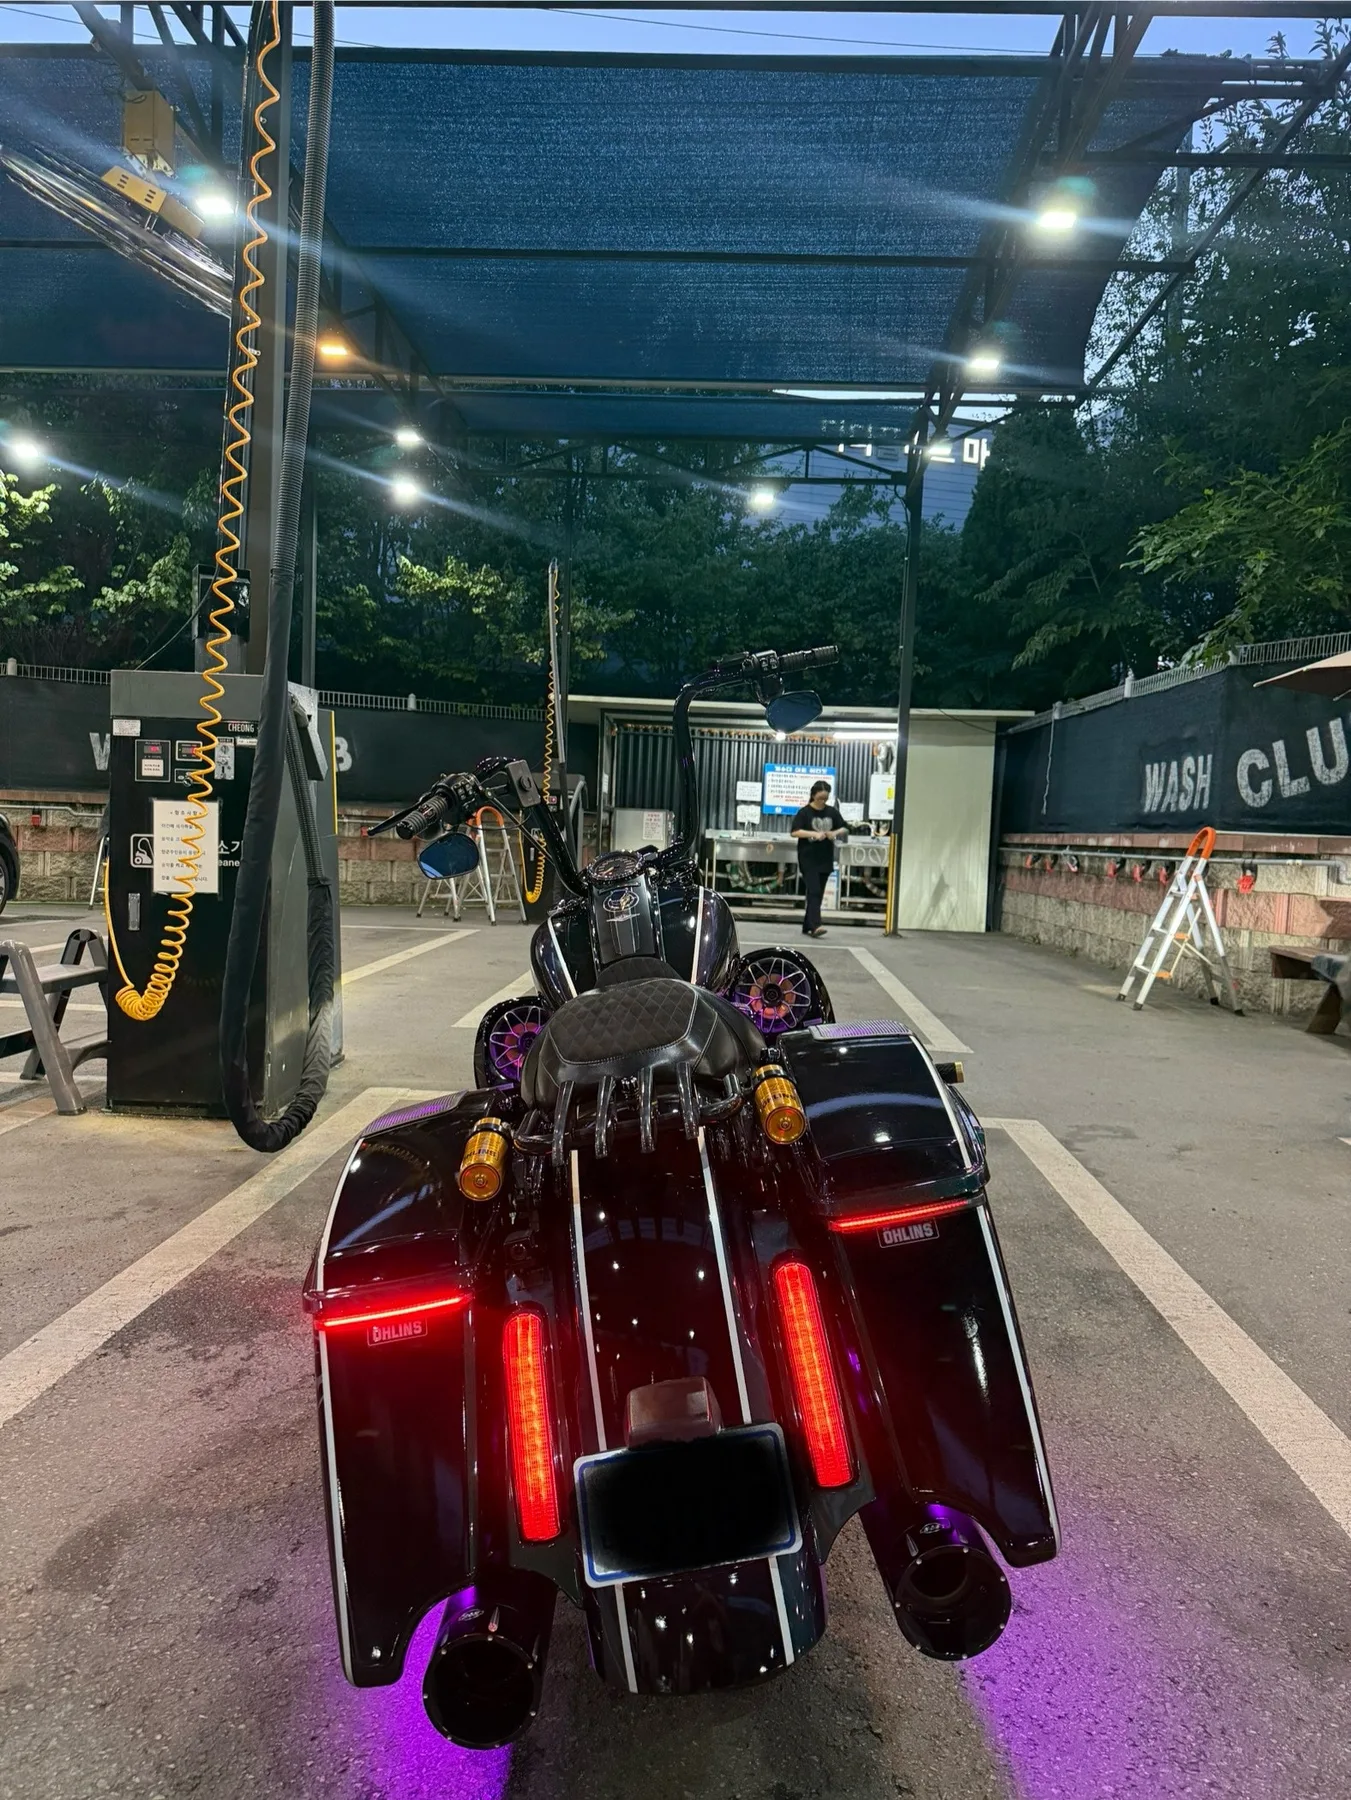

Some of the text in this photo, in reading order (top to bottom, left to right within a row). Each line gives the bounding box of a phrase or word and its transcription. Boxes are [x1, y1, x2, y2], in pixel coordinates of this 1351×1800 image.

[227, 723, 255, 733] CHEONG
[1144, 717, 1351, 813] WASH CLU
[218, 840, 244, 855] 소기
[218, 859, 241, 867] eane
[882, 1222, 934, 1245] ÖHLINS
